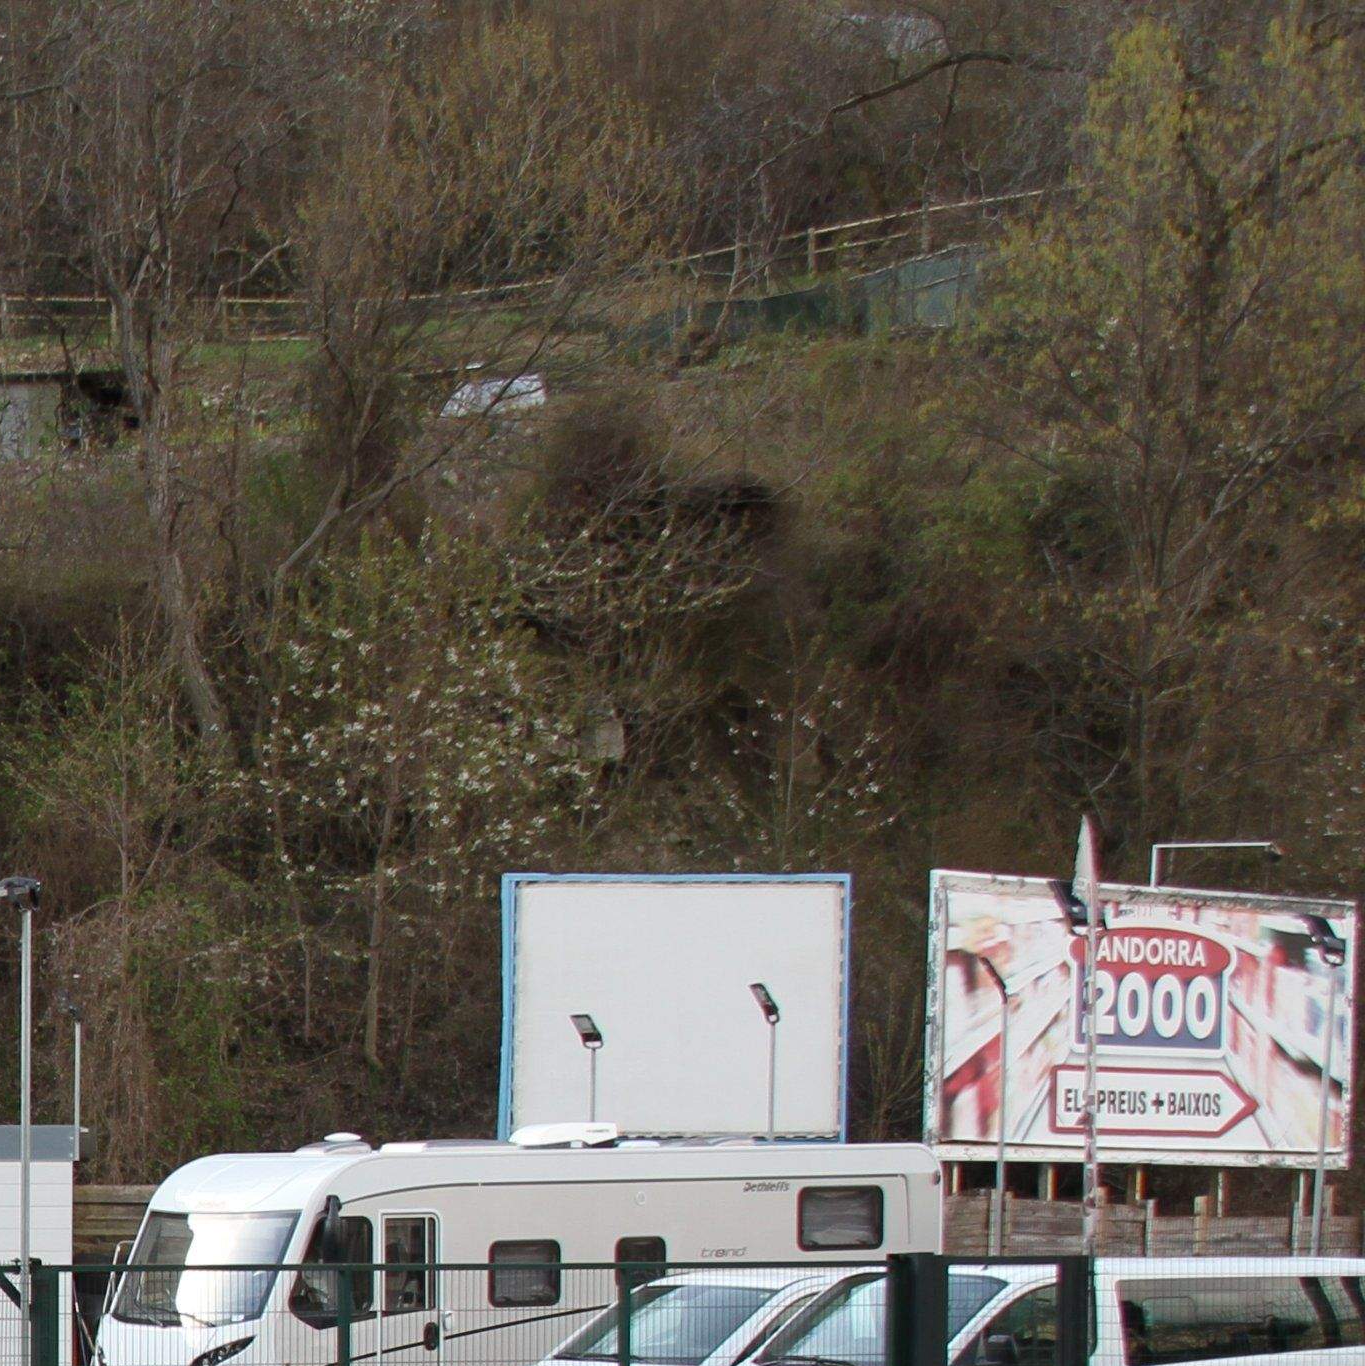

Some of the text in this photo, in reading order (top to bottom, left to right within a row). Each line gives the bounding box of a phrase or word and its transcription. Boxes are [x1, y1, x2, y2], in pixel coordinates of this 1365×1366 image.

[1095, 935, 1207, 968] ANDORRA
[1082, 969, 1217, 1040] 2000
[1096, 1089, 1147, 1115] PREUS
[1168, 1092, 1222, 1117] BAIXOS
